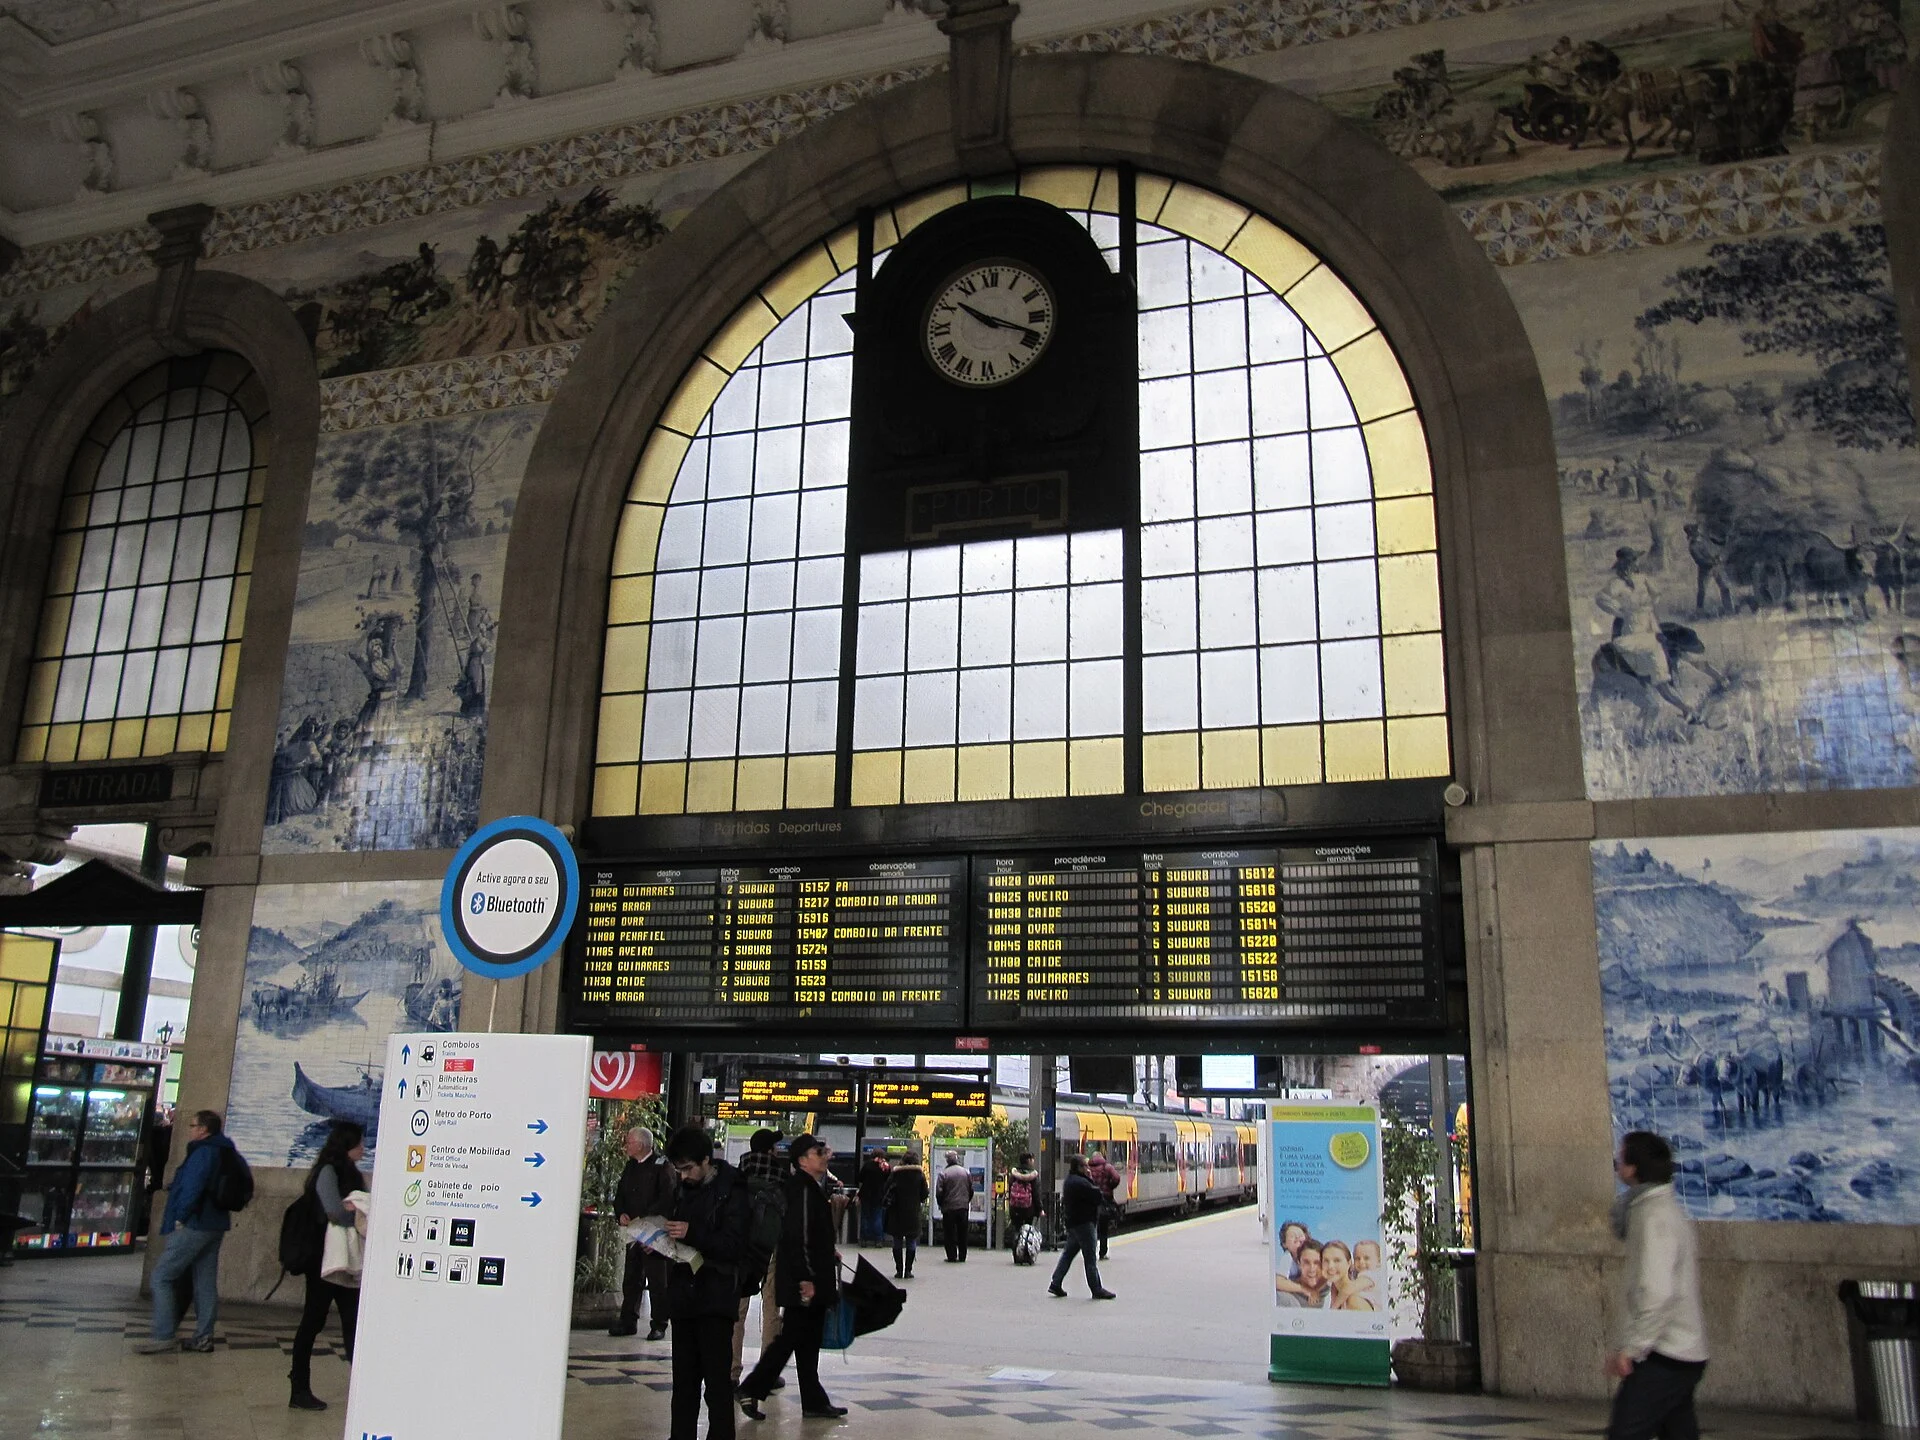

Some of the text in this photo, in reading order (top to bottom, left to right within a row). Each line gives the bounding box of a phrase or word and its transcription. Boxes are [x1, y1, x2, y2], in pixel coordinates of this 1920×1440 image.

[52, 773, 160, 799] ENTRADA
[778, 821, 842, 834] Departures
[1055, 856, 1106, 864] procedência
[769, 865, 800, 875] comboio
[869, 863, 916, 871] observações
[477, 872, 501, 883] Active
[503, 875, 525, 886] agora
[535, 876, 549, 884] seu
[988, 875, 1021, 887] 10H20
[1028, 874, 1055, 886] OVAR
[1152, 871, 1159, 882] 6
[1167, 870, 1208, 882] SUBURB
[590, 881, 848, 897] 10H20 GUIMARAES 2 SUBURB 15157 PA
[988, 891, 1021, 902] 10H25
[1028, 890, 1068, 902] AVEIRO
[1153, 888, 1159, 899] 1
[1167, 886, 1209, 898] SUBURB
[590, 894, 937, 912] 10H45 BRAGA 1 SUBURB 15217 COMBOIO DA CAUDA
[988, 901, 1276, 919] 10H30 CAIDE 2 SUBURB 15520
[589, 913, 828, 927] 10H50 OVAR 3 SUBURB 15916
[588, 925, 942, 941] 11H00 PENAFIEL 5 SUBURB 15407 COMBOIO DA FRENTE
[988, 924, 1021, 935] 10H40
[1028, 923, 1055, 934] OVAR
[1153, 921, 1160, 933] 3
[1167, 920, 1210, 932] SUBURB
[587, 944, 827, 956] 11H05 AVEIRO 5 SUBURB 15724
[988, 935, 1277, 952] 10H45 BRAGA 5 SUBURB 15220
[586, 960, 827, 971] 11H20 GUIMARAES 3 SUBURB 15159
[988, 952, 1277, 968] 11H00 CAIDE 1 SUBURB 15522
[584, 975, 826, 987] 11H30 CAIDE 2 SUBURB 15523
[988, 973, 1020, 984] 11H05
[1027, 972, 1089, 984] GUIMARAES
[1154, 972, 1160, 983] 3
[1168, 971, 1210, 982] SUBURB
[583, 990, 940, 1002] 11H45 BRAGA 4 SUBURB 15219 COMBOIO DA FRENTE
[988, 989, 1020, 1000] 11H25
[1027, 989, 1068, 1000] AVEIRO
[1154, 988, 1160, 1001] 3
[1168, 988, 1211, 1000] SUBURB
[439, 1075, 477, 1083] Bilheteiras
[470, 1111, 491, 1119] Porto
[432, 1145, 510, 1155] Centro de Mobilidad
[428, 1180, 460, 1189] Gabinete
[463, 1182, 472, 1190] de
[482, 1202, 498, 1210] Office
[456, 1227, 468, 1235] MB
